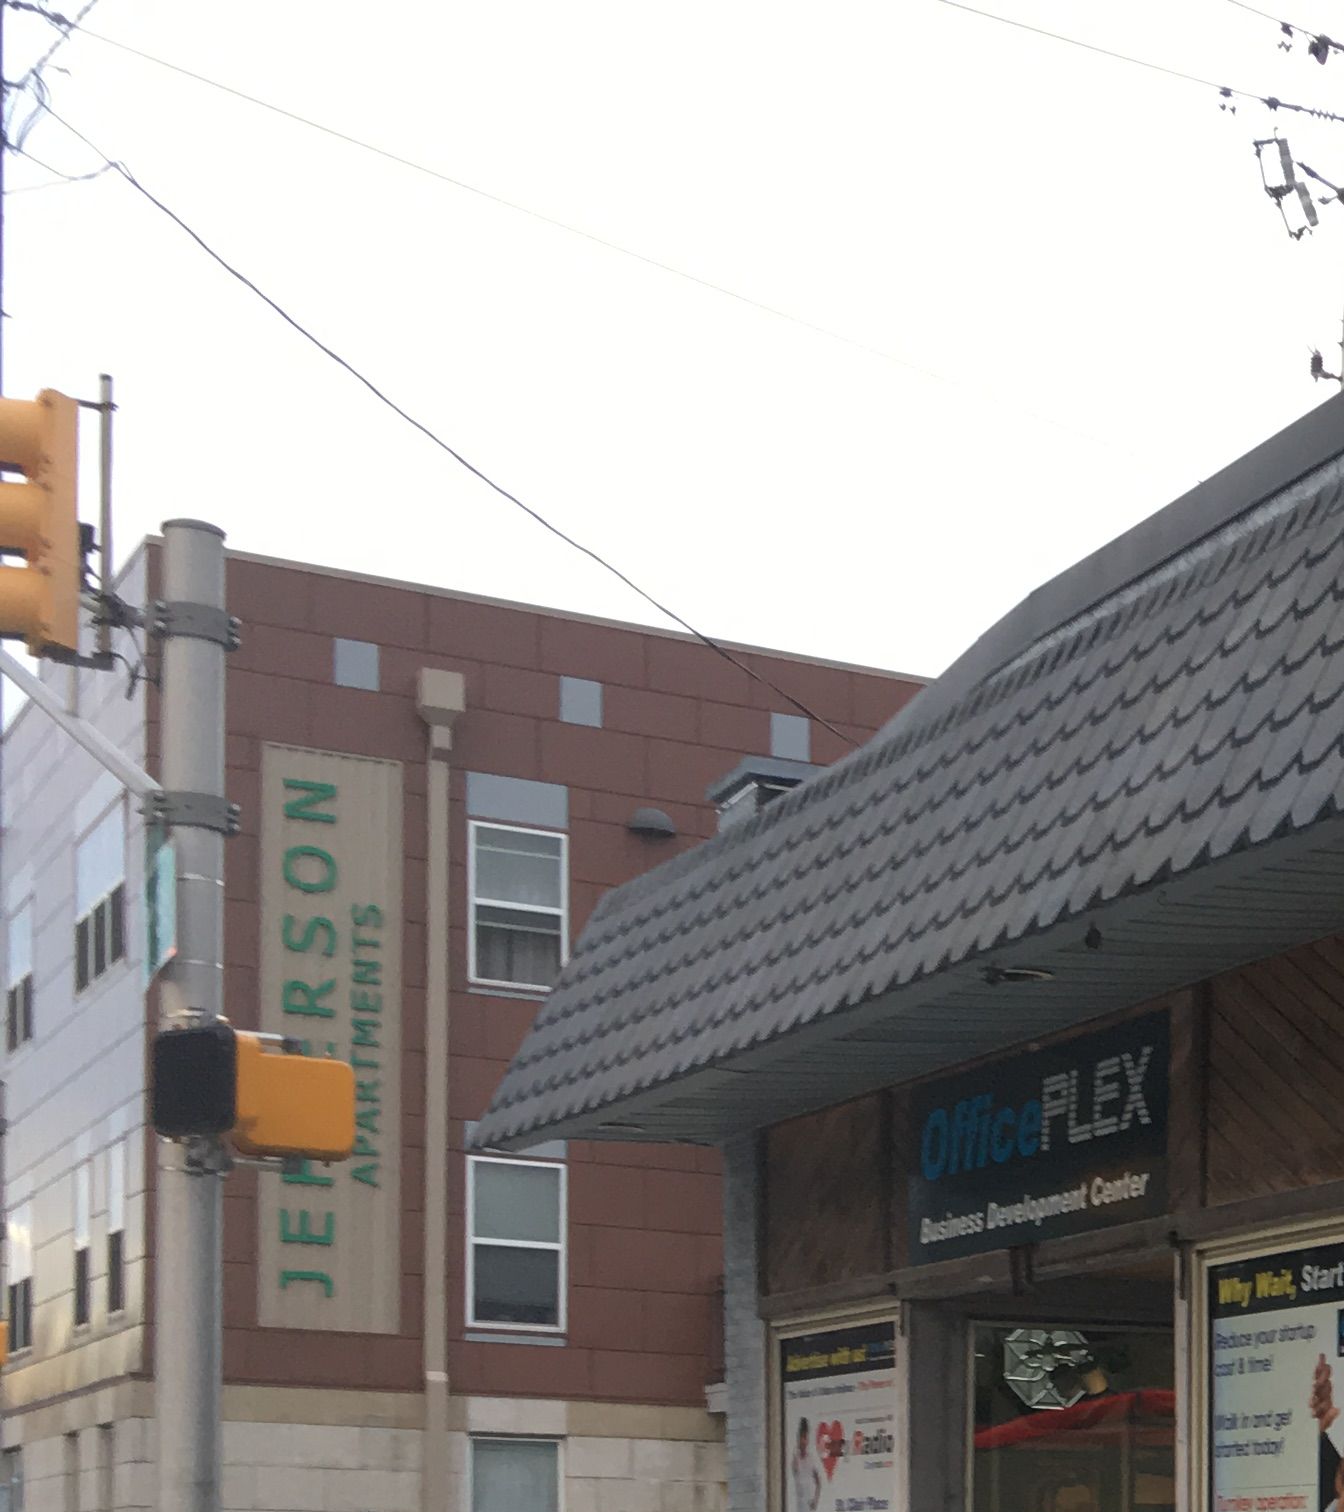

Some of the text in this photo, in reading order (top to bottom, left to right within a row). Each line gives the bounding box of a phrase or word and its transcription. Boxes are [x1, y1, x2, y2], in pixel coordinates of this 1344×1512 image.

[281, 777, 337, 1298] JEFRSON
[350, 903, 384, 1187] APARTMENTS
[920, 1046, 1154, 1182] OfficePLEX
[919, 1170, 1150, 1245] Business Development Center
[1218, 1278, 1252, 1307] Why
[1301, 1261, 1344, 1292] Start
